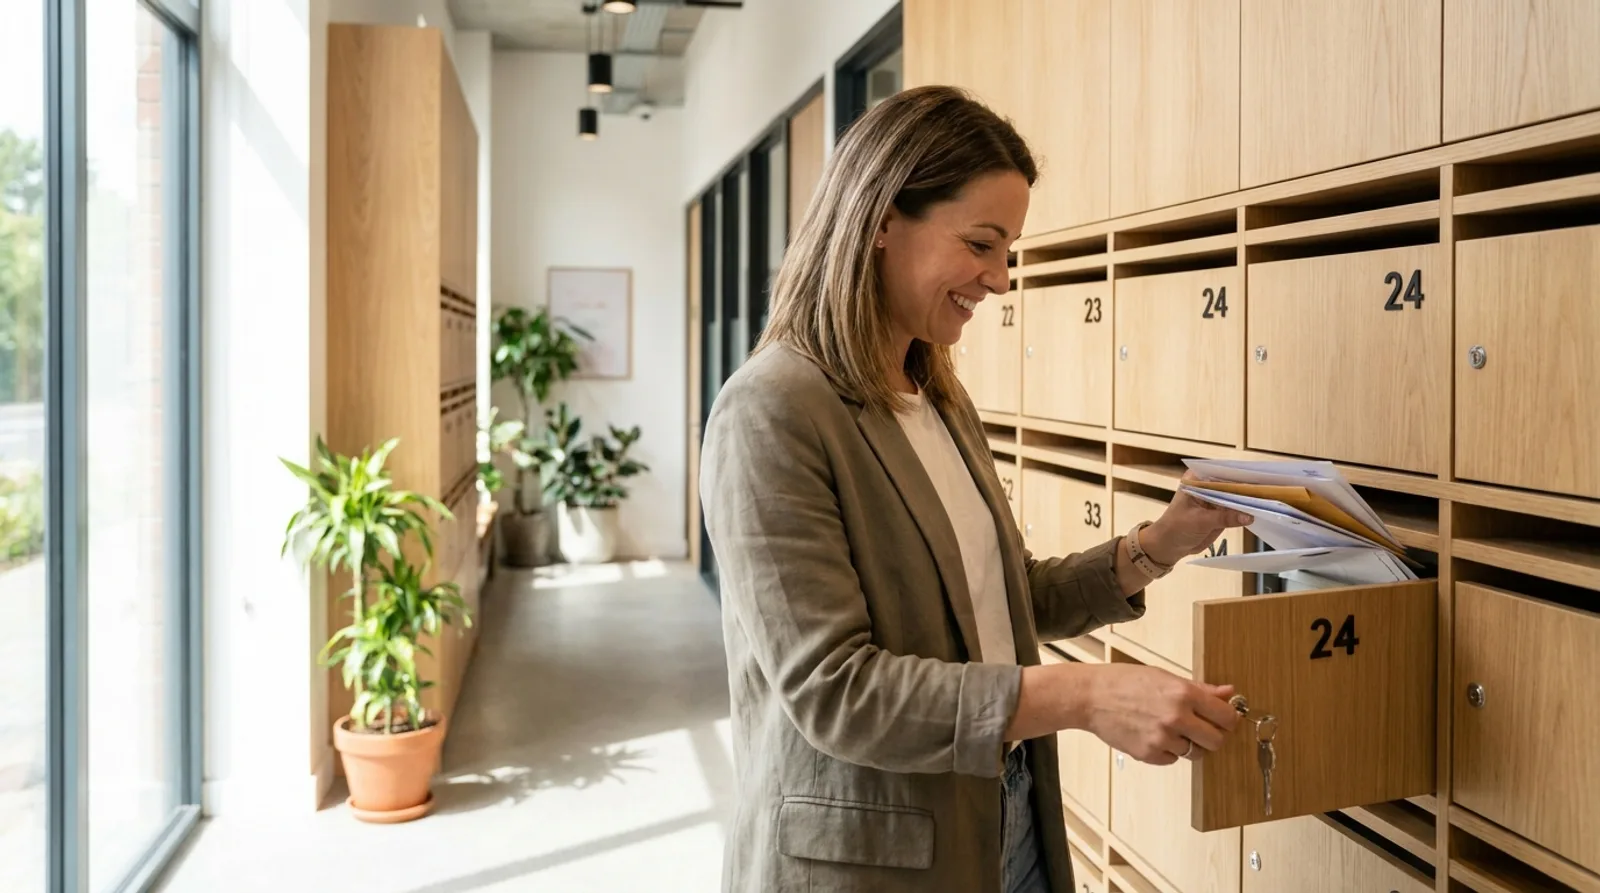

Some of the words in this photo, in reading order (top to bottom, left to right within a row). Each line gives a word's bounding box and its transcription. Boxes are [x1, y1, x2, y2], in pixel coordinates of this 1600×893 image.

[1202, 286, 1228, 319] 24
[1383, 269, 1425, 311] 24
[1002, 305, 1014, 327] 22
[1084, 297, 1102, 323] 23
[1084, 501, 1101, 529] 33
[1309, 614, 1360, 660] 24
